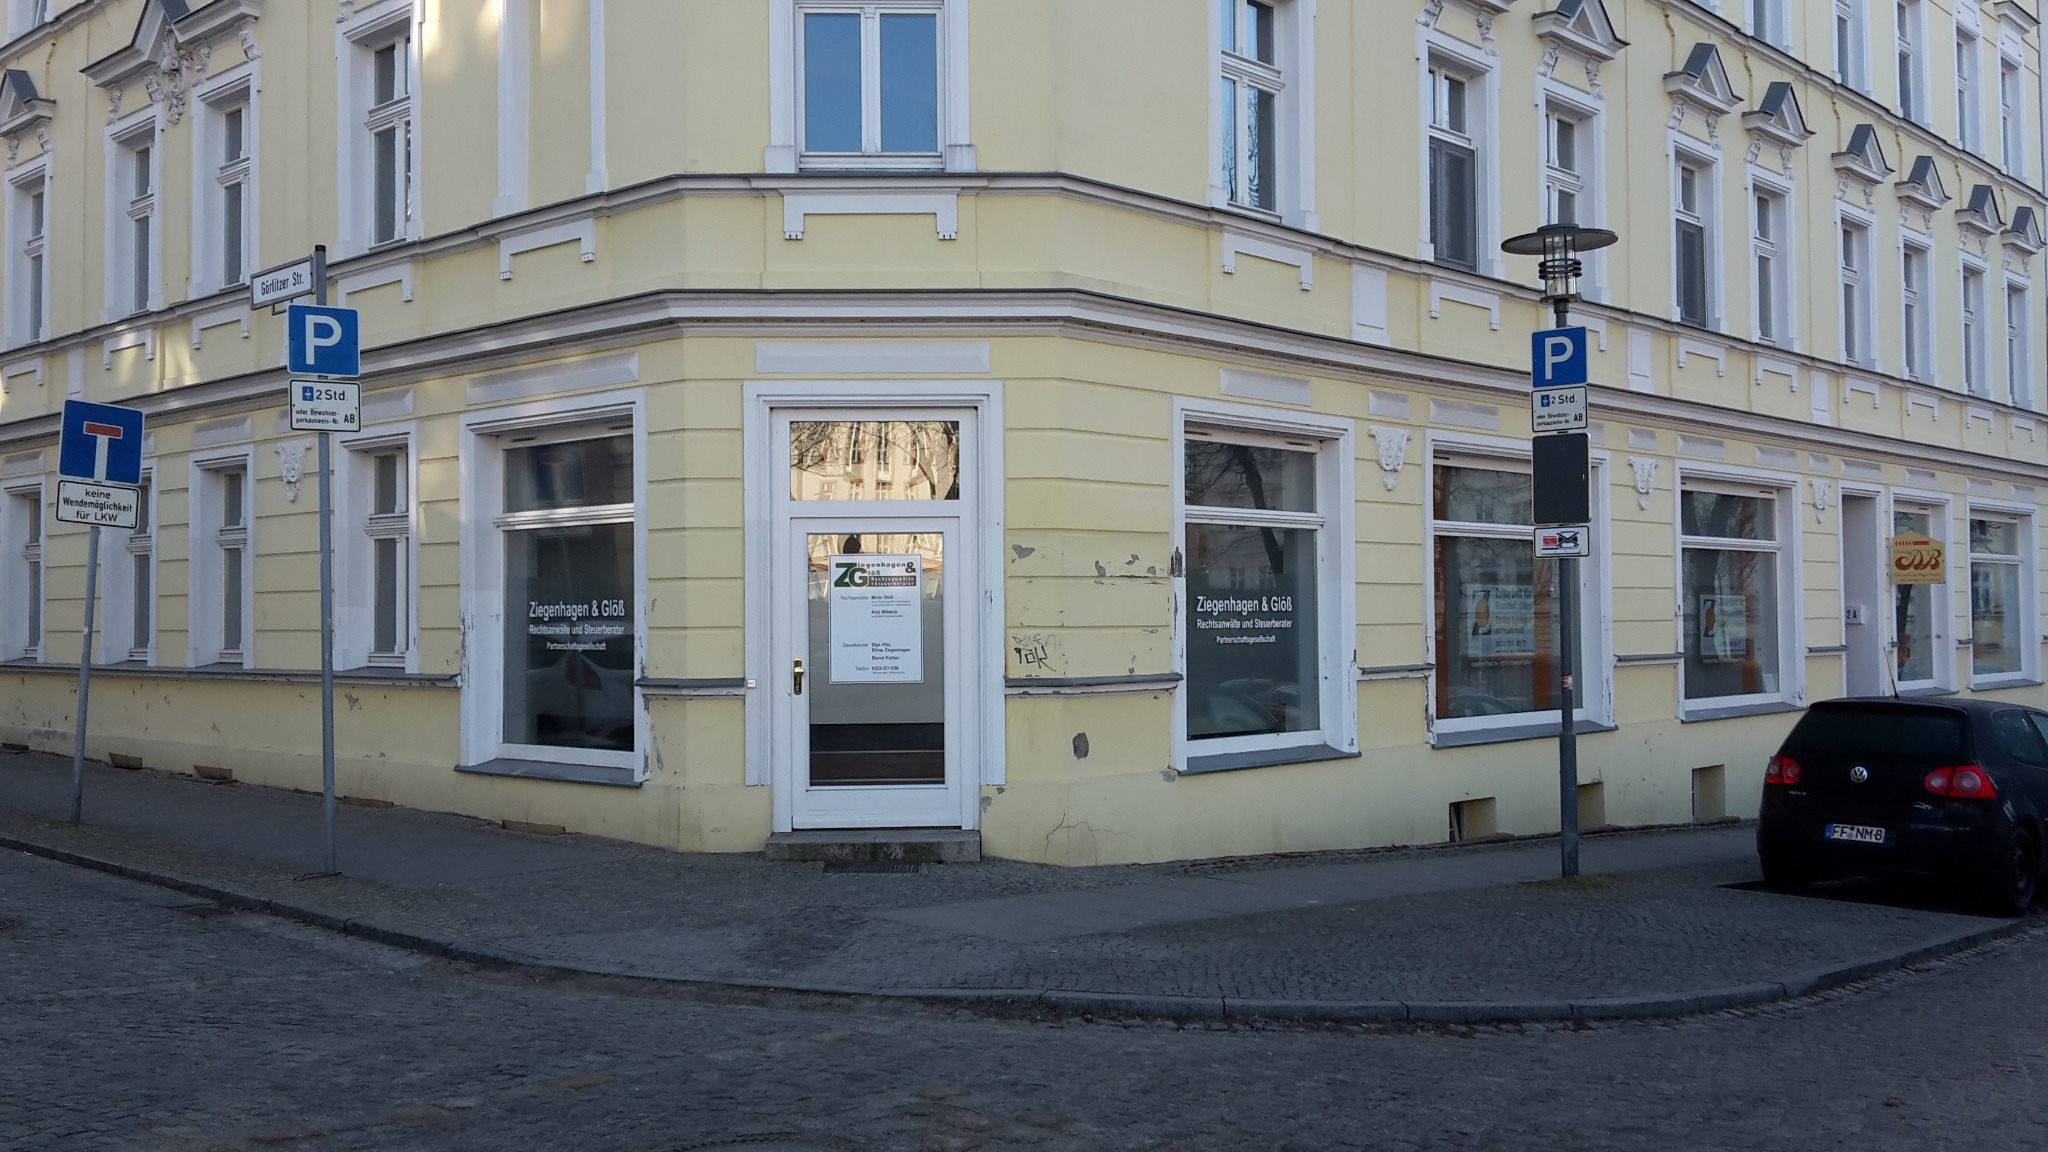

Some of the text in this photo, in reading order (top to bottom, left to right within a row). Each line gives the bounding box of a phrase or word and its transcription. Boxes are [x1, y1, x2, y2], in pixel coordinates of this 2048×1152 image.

[260, 271, 304, 296] Görlitzer Str.
[305, 314, 342, 365] P
[1545, 336, 1574, 380] P
[315, 389, 349, 401] 2 Std.
[1551, 394, 1578, 404] 2 Std.
[343, 413, 356, 424] AB
[1573, 412, 1583, 422] AB
[85, 488, 111, 499] keine
[62, 497, 133, 512] Wendemöglichkeit
[76, 510, 118, 522] für LKW
[529, 599, 625, 621] Ziegenhagen & Glöß
[1196, 596, 1293, 616] Ziegenhagen & Glöß
[529, 623, 625, 635] Rechtsanwälte und Steuerberater
[1196, 618, 1292, 629] Rechtsanwälte und Steuerberater
[1216, 634, 1276, 645] Partnerschaftsgesellschaft
[546, 641, 607, 652] Partnerschaftsgesellschaft
[1832, 825, 1849, 837] FF
